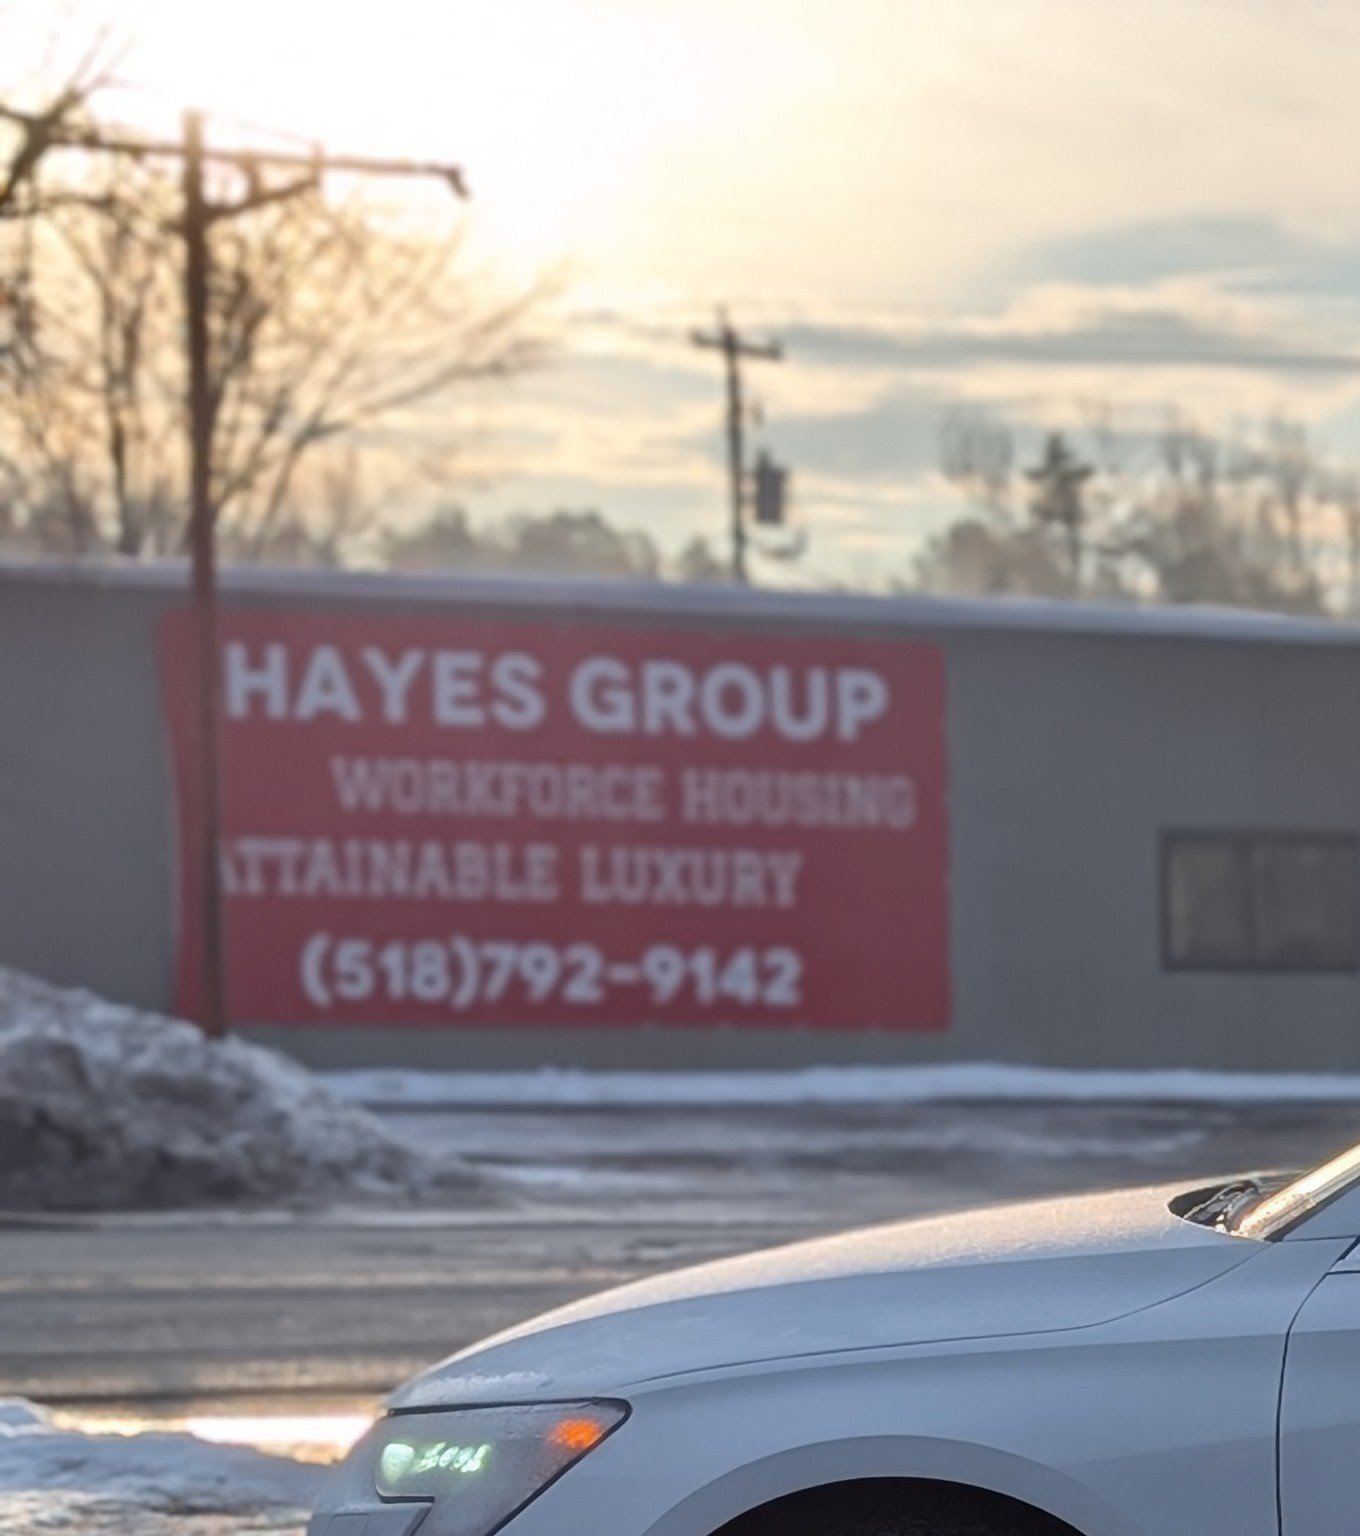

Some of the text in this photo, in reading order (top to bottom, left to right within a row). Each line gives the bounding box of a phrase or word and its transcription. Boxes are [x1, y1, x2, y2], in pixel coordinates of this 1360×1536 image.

[226, 643, 888, 742] HAYES GROUP
[333, 758, 917, 830] WORKFORCE HOUSING
[581, 850, 805, 910] LUXURY
[300, 932, 806, 1010] (518)792-9142
